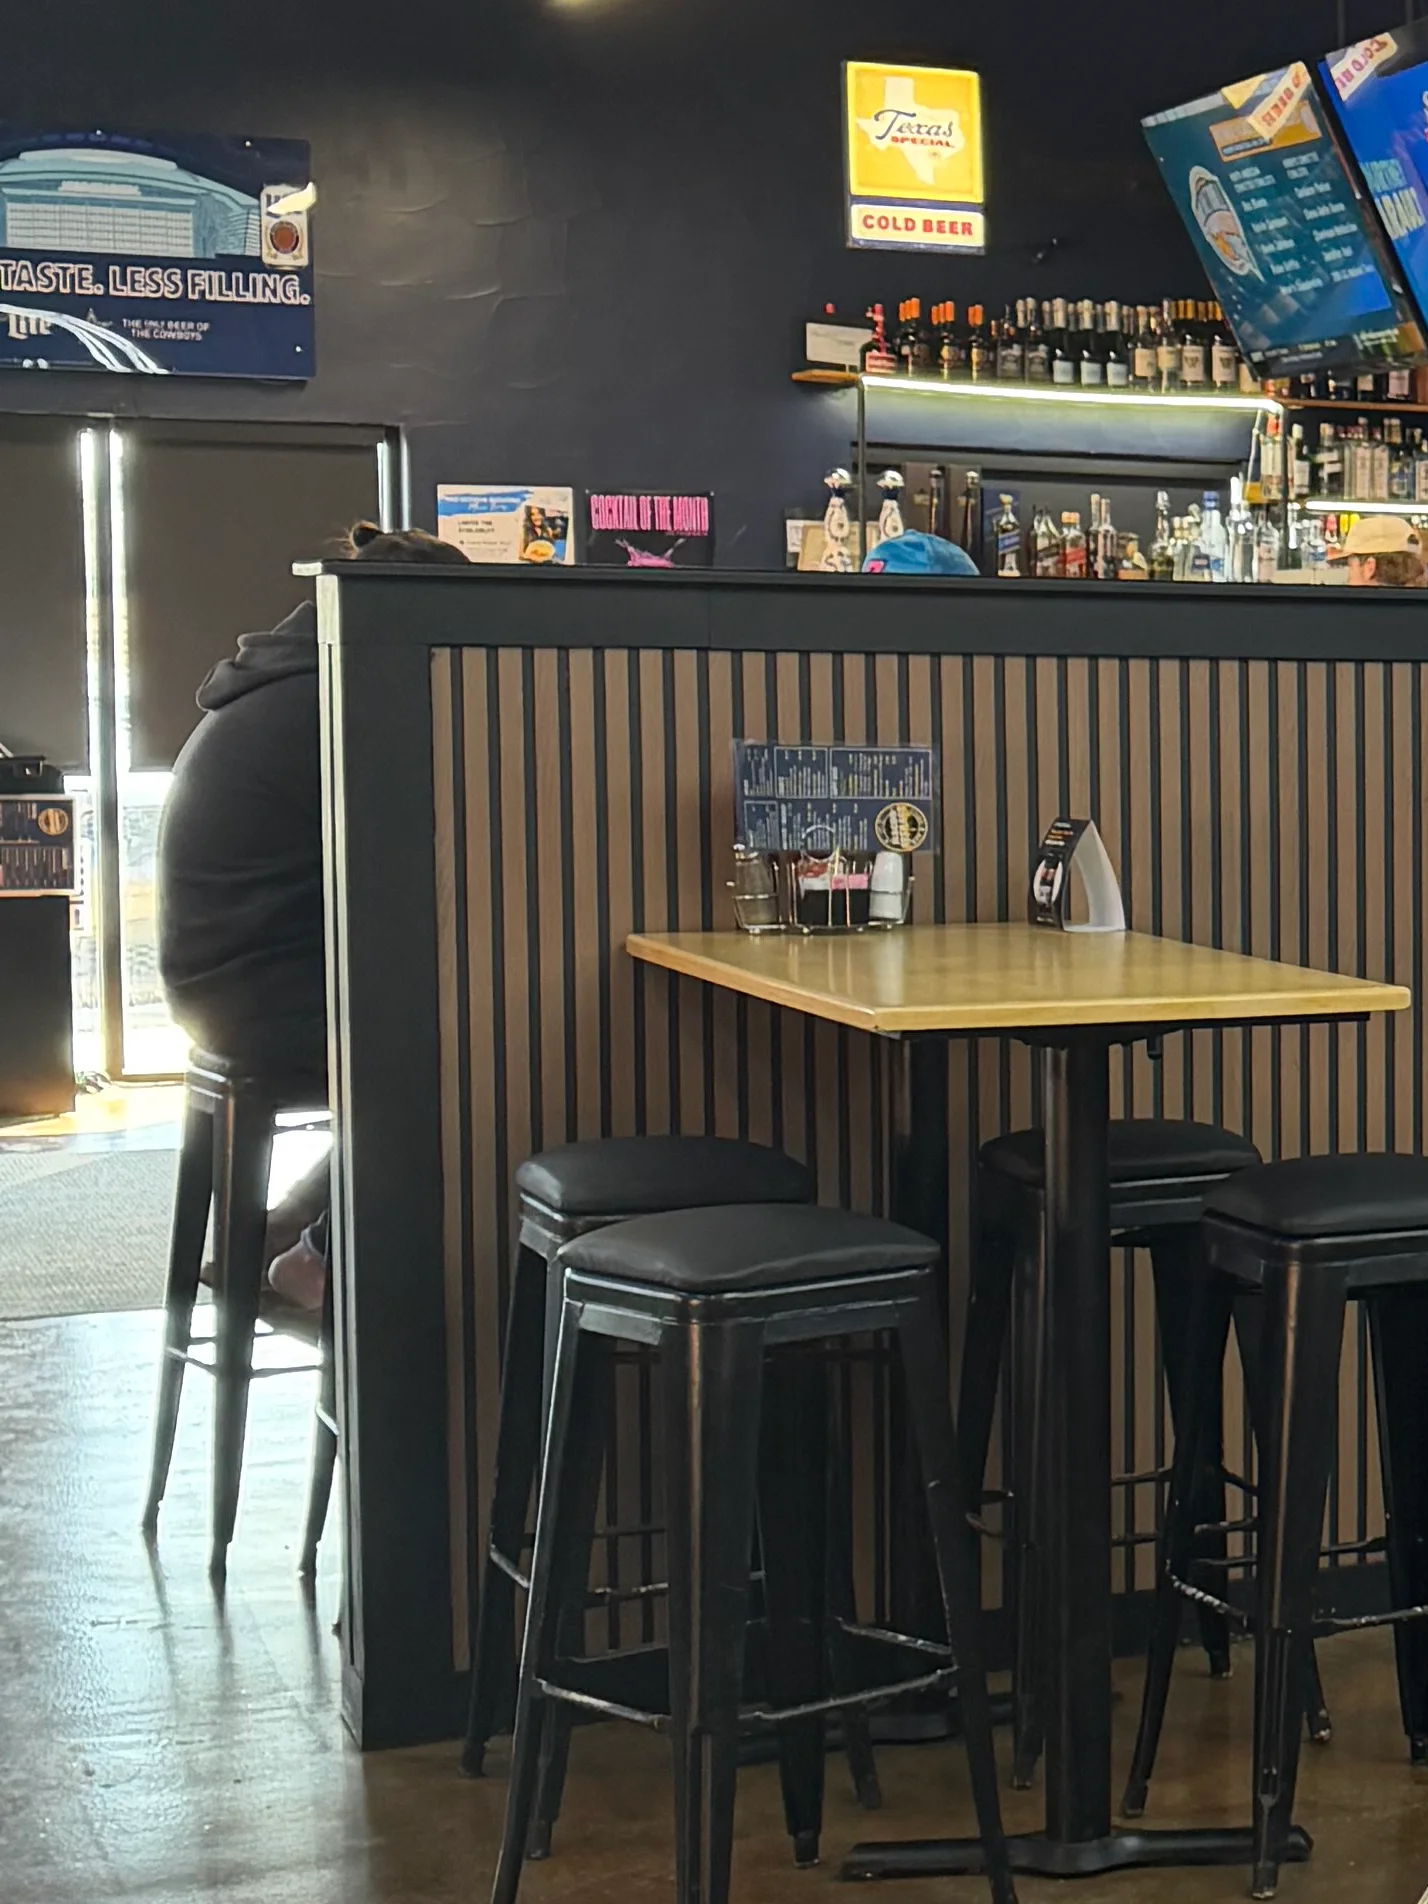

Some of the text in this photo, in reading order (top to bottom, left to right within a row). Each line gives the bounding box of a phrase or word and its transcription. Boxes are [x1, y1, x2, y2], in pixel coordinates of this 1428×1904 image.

[874, 109, 953, 140] Texas
[891, 136, 955, 148] SPECIAL
[863, 215, 973, 236] COLD BEER
[0, 259, 311, 305] TASTE. LESS FILLING.
[639, 495, 651, 530] OF
[653, 495, 672, 531] THE
[672, 496, 709, 532] MONTH
